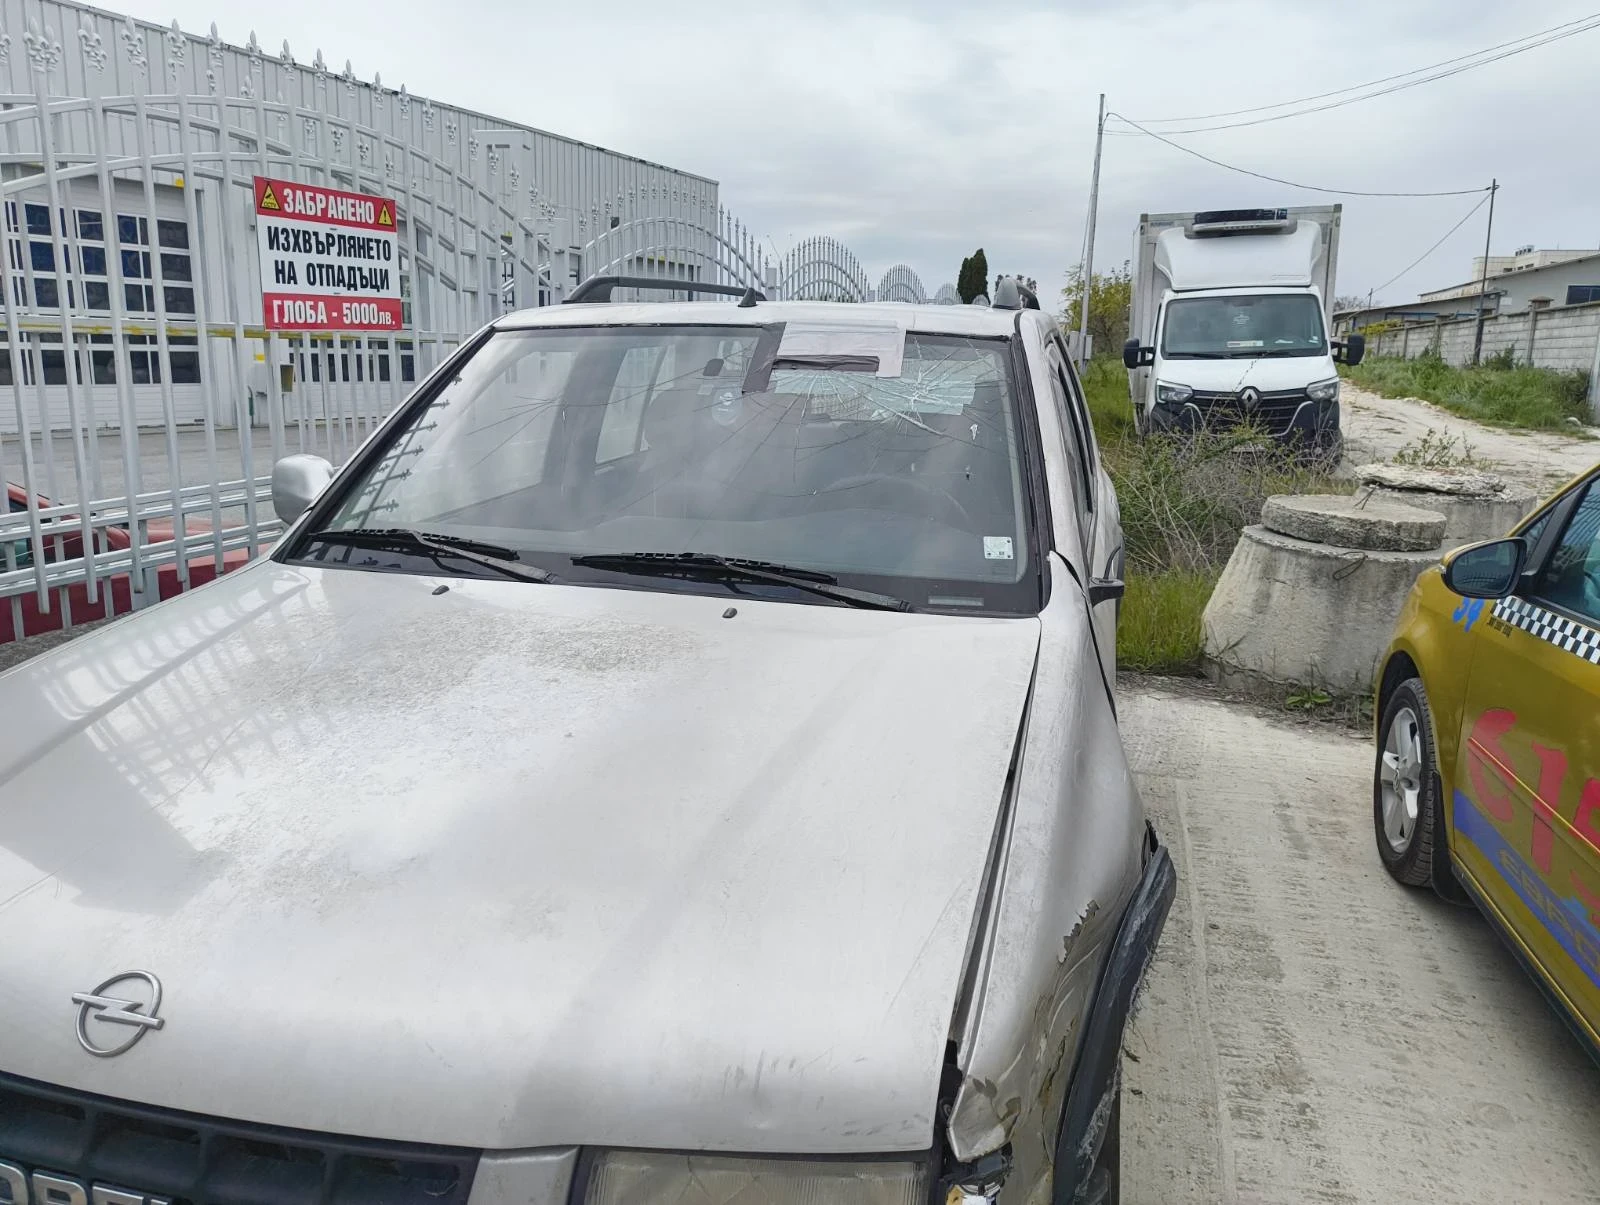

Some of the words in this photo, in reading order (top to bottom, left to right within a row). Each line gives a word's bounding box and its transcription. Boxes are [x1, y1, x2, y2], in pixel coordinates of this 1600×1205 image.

[284, 189, 375, 224] ЗАБРАНЕНО
[267, 225, 392, 262] ИЗХВЪРЛЯНЕТО
[274, 259, 298, 285] НА
[306, 262, 390, 293] ОТПАДЪЦИ
[272, 299, 328, 324] ГЛОБА
[342, 302, 396, 326] 5000лв.
